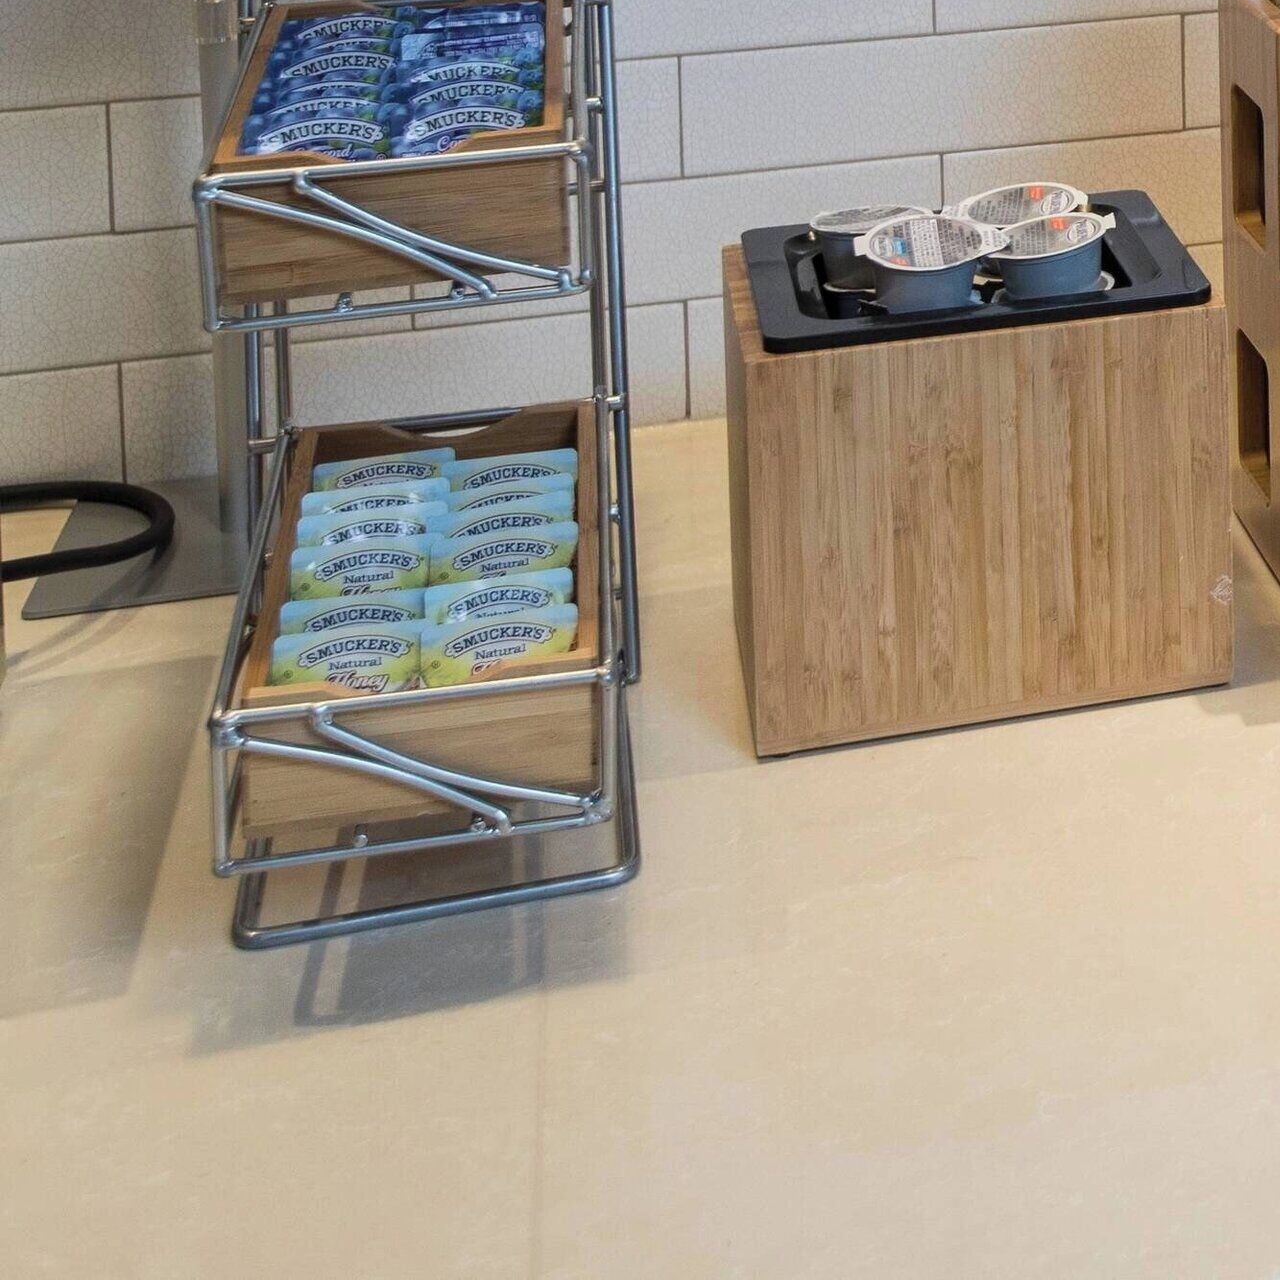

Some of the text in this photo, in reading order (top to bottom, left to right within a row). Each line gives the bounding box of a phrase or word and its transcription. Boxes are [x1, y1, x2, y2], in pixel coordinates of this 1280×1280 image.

[413, 111, 517, 136] SMUCKER'S
[342, 464, 427, 486] SMUCKER'S
[321, 553, 412, 577] SMUCKER'S
[460, 542, 547, 567] SMUCKER'S
[480, 558, 529, 573] Natural
[344, 570, 395, 584] Natural
[455, 589, 542, 612] SMUCKER'S
[306, 639, 402, 663] SMUCKER'S
[452, 626, 545, 653] SMUCKER'S
[475, 643, 526, 660] Natural
[329, 657, 382, 671] Natural
